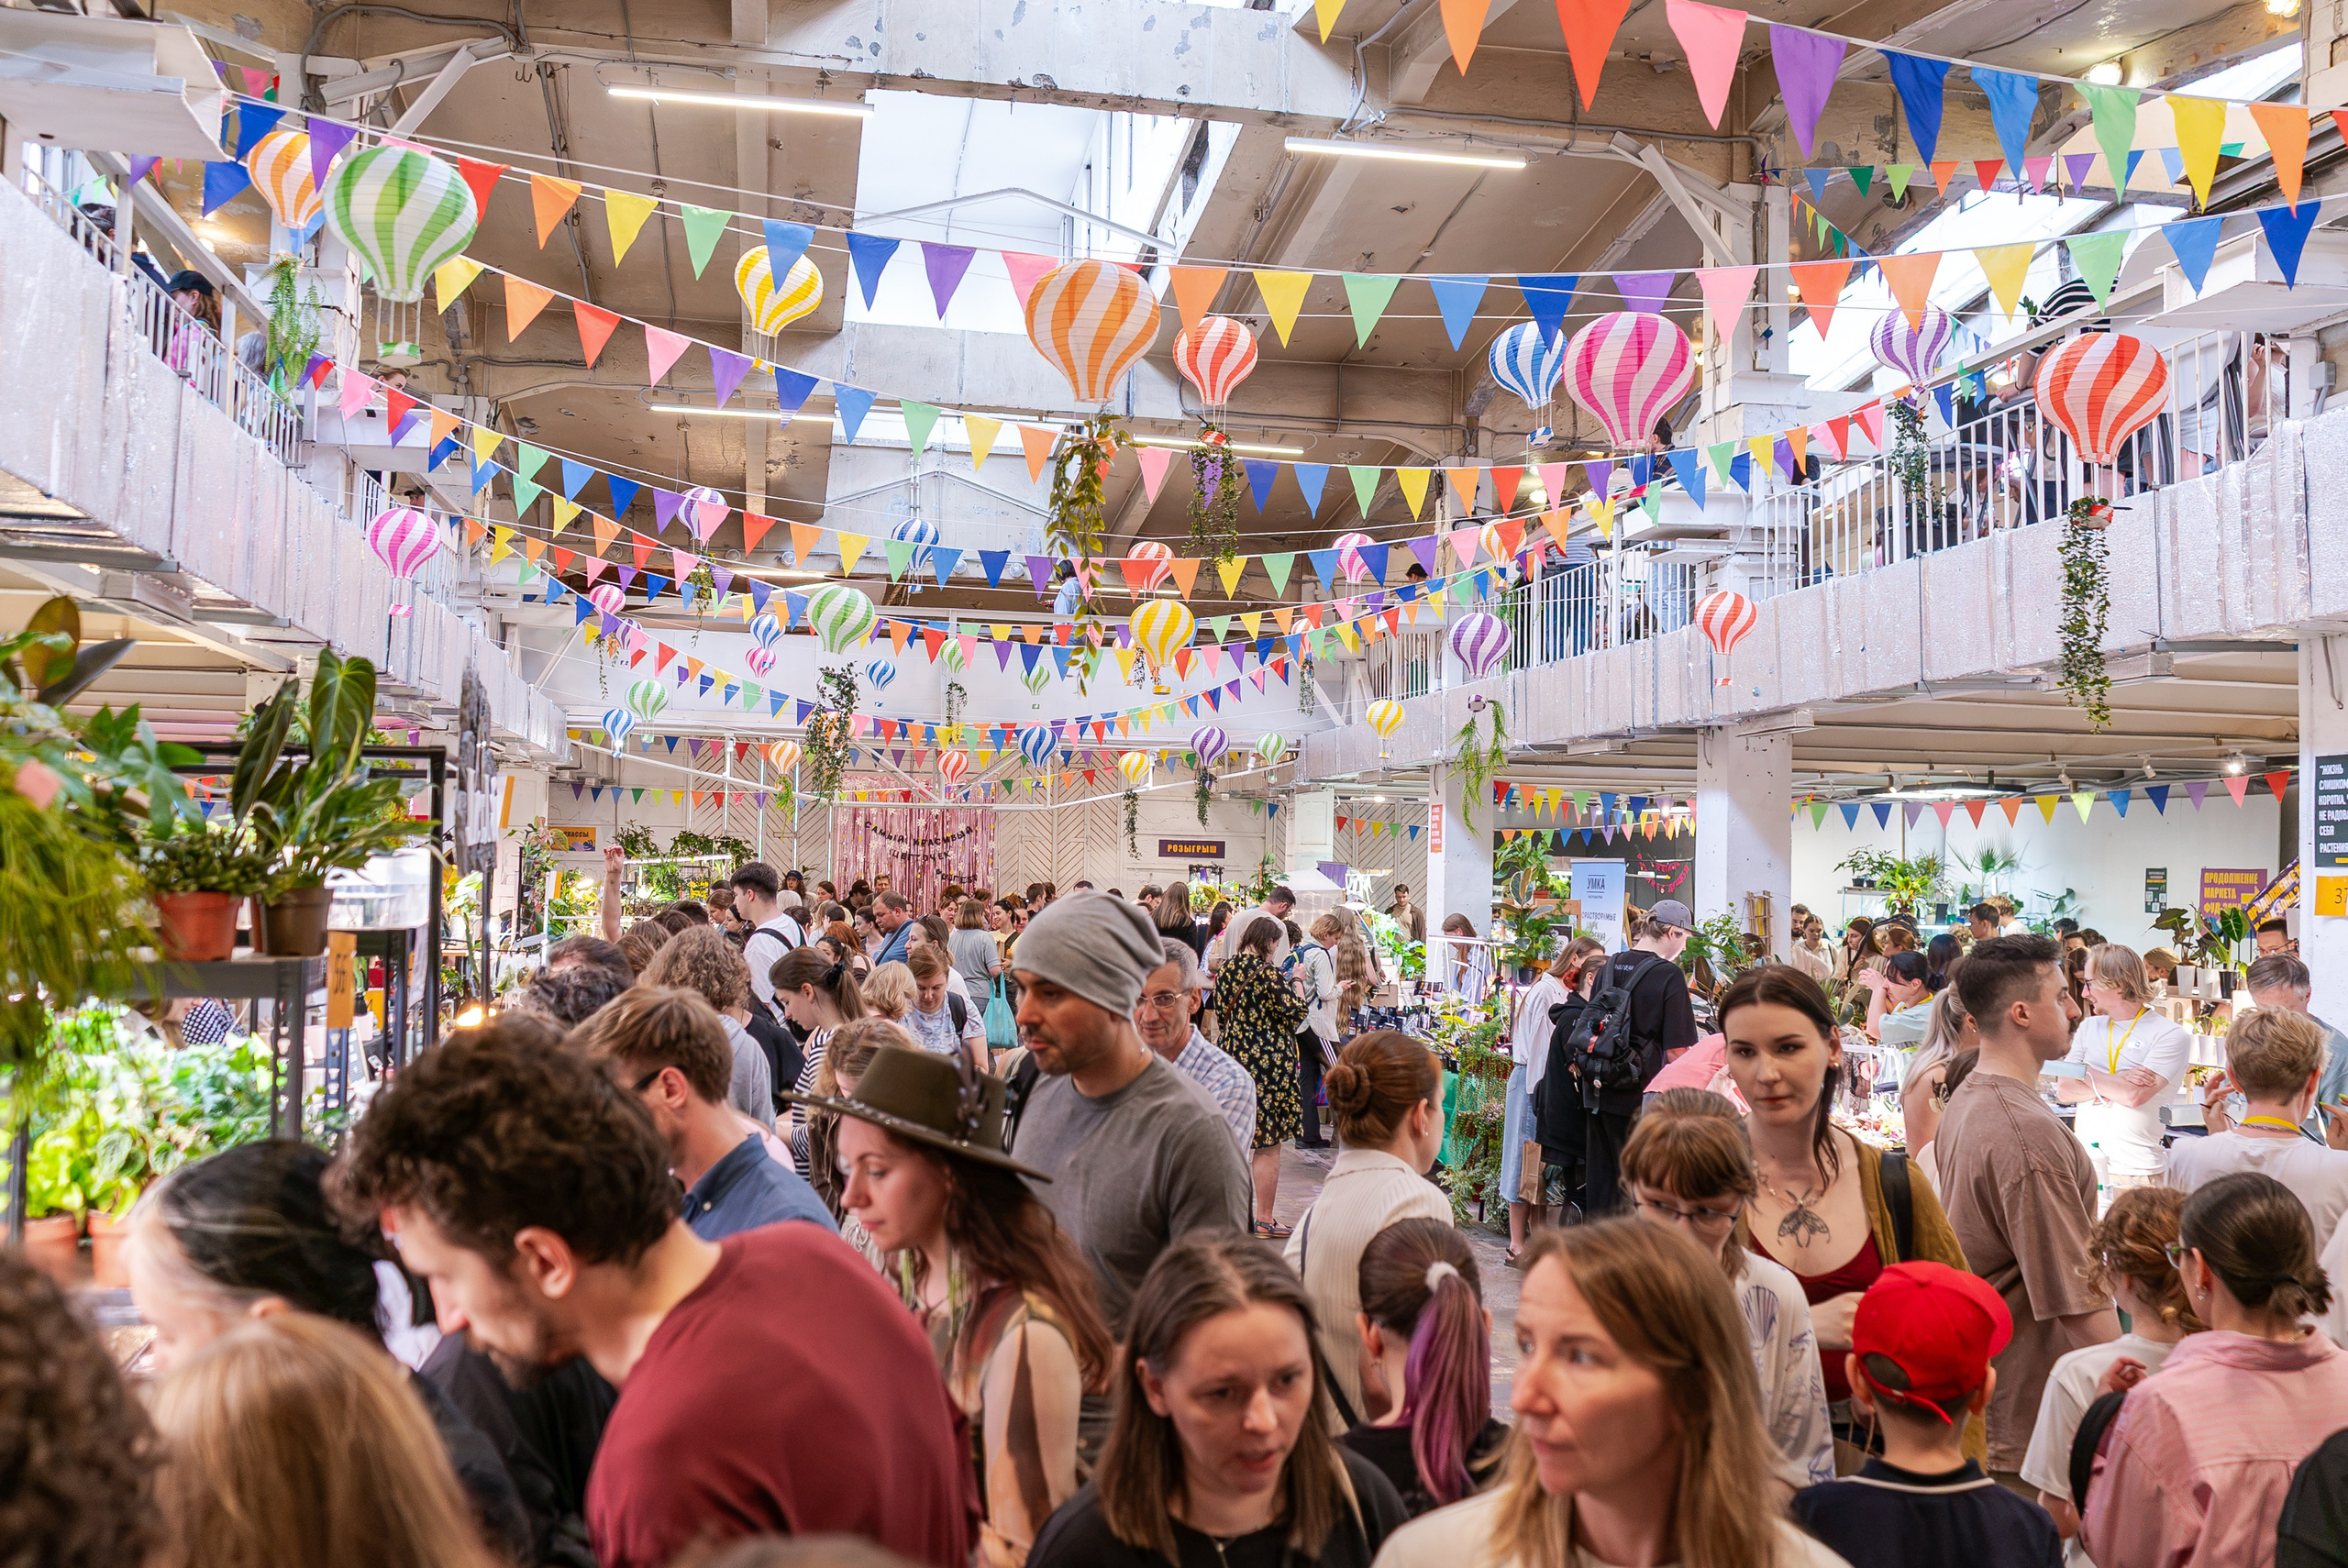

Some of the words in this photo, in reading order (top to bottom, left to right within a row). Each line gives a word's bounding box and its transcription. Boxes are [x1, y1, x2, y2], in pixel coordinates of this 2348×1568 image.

[2319, 811, 2327, 821] НЕ
[2319, 825, 2334, 836] СЕБЯ
[1167, 844, 1217, 854] РОЗЫГРЫШ
[1587, 878, 1605, 889] УМКА
[2204, 872, 2258, 885] ПРОДОЛЖЕНИЕ
[2204, 887, 2236, 899] МАРКЕТА
[2247, 869, 2298, 922] ПРОДОЛЖЕНИЕ
